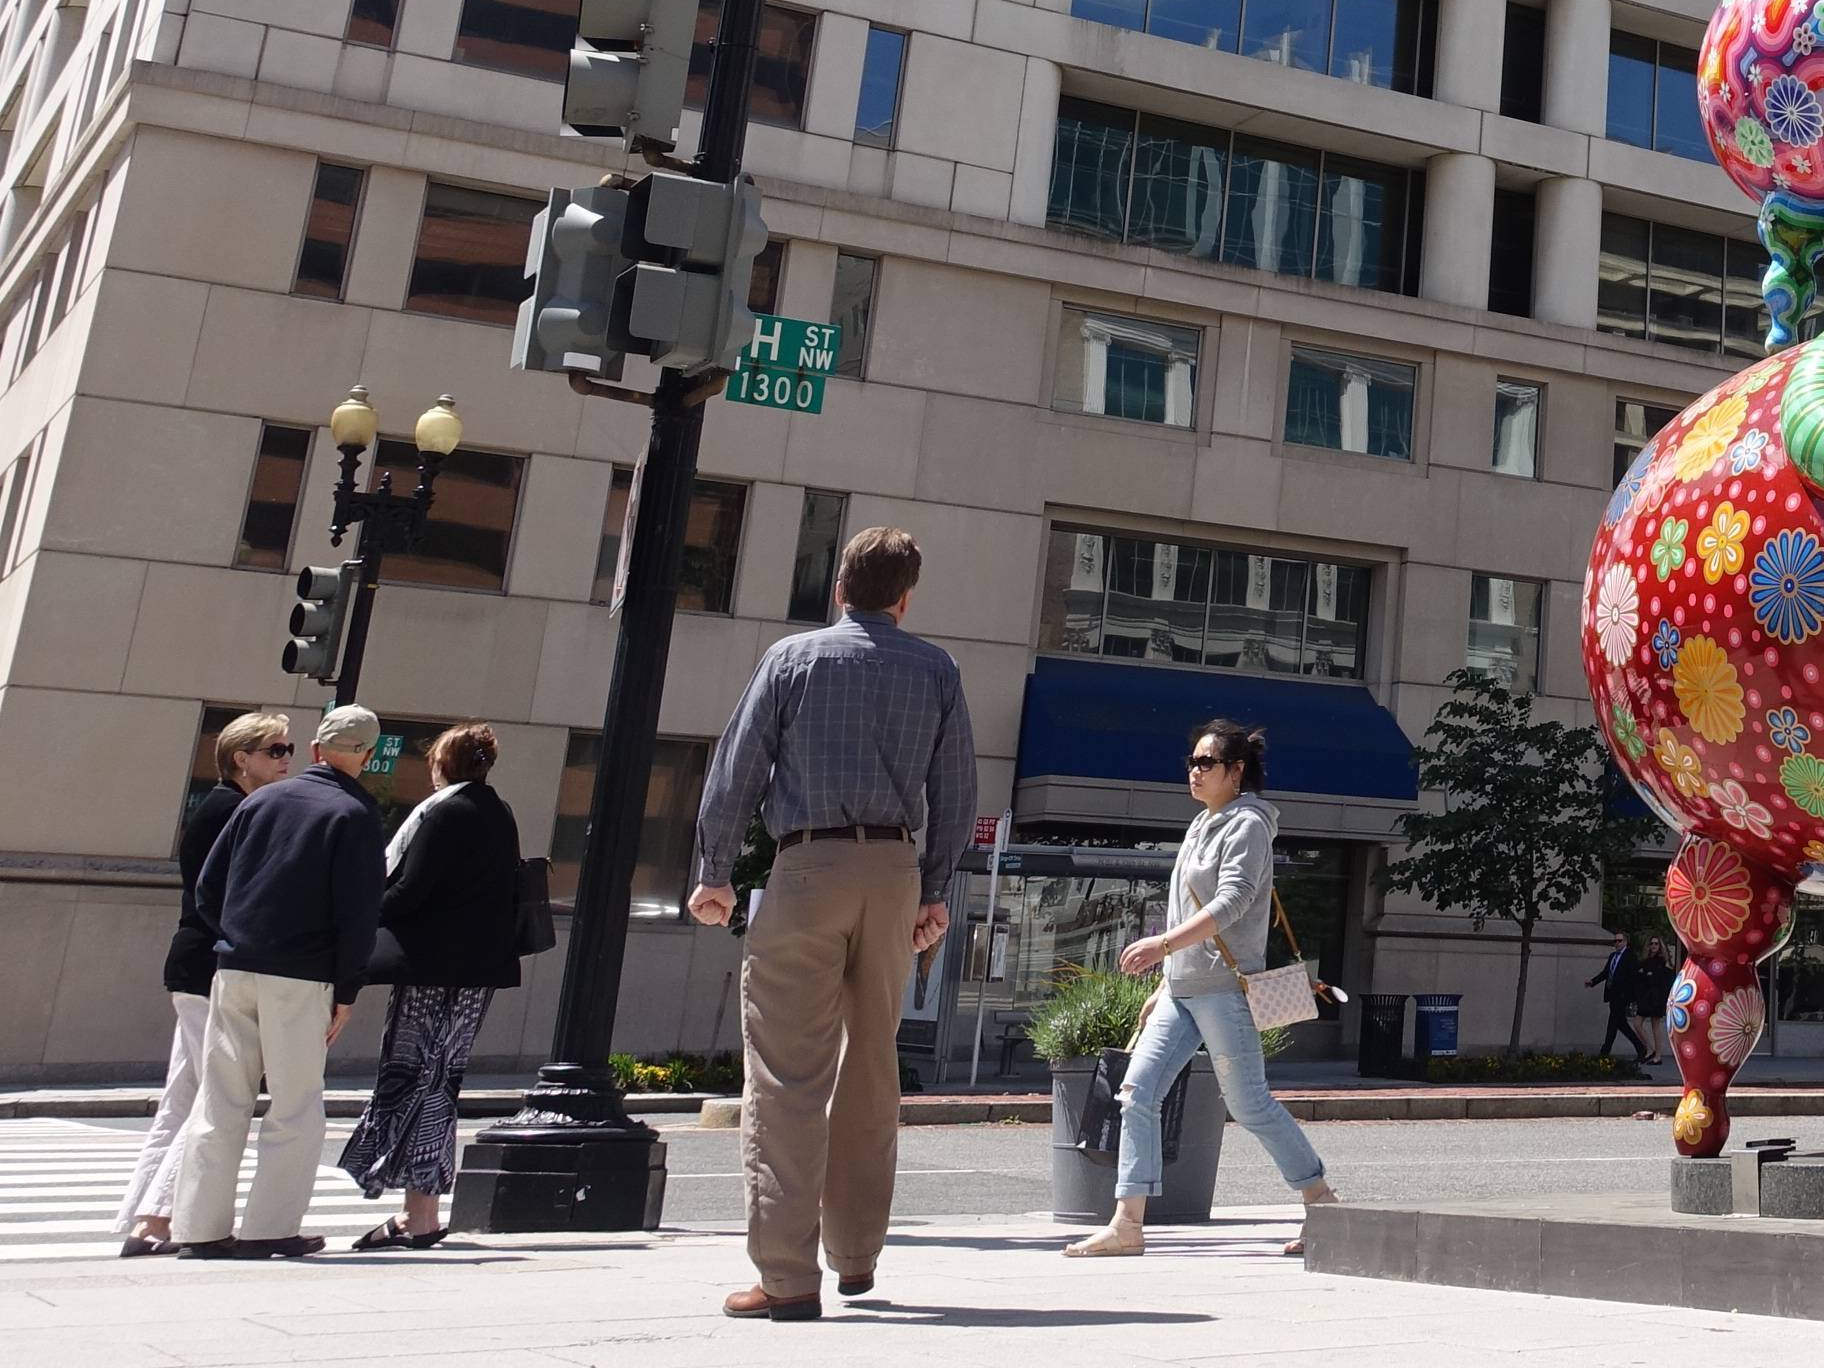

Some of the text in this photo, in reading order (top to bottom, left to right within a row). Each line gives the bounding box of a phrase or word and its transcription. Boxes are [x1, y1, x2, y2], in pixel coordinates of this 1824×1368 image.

[750, 318, 835, 361] H ST
[798, 346, 834, 371] NW
[739, 371, 813, 408] 1300
[383, 746, 401, 757] NW
[386, 737, 401, 747] ST
[363, 759, 390, 772] 300
